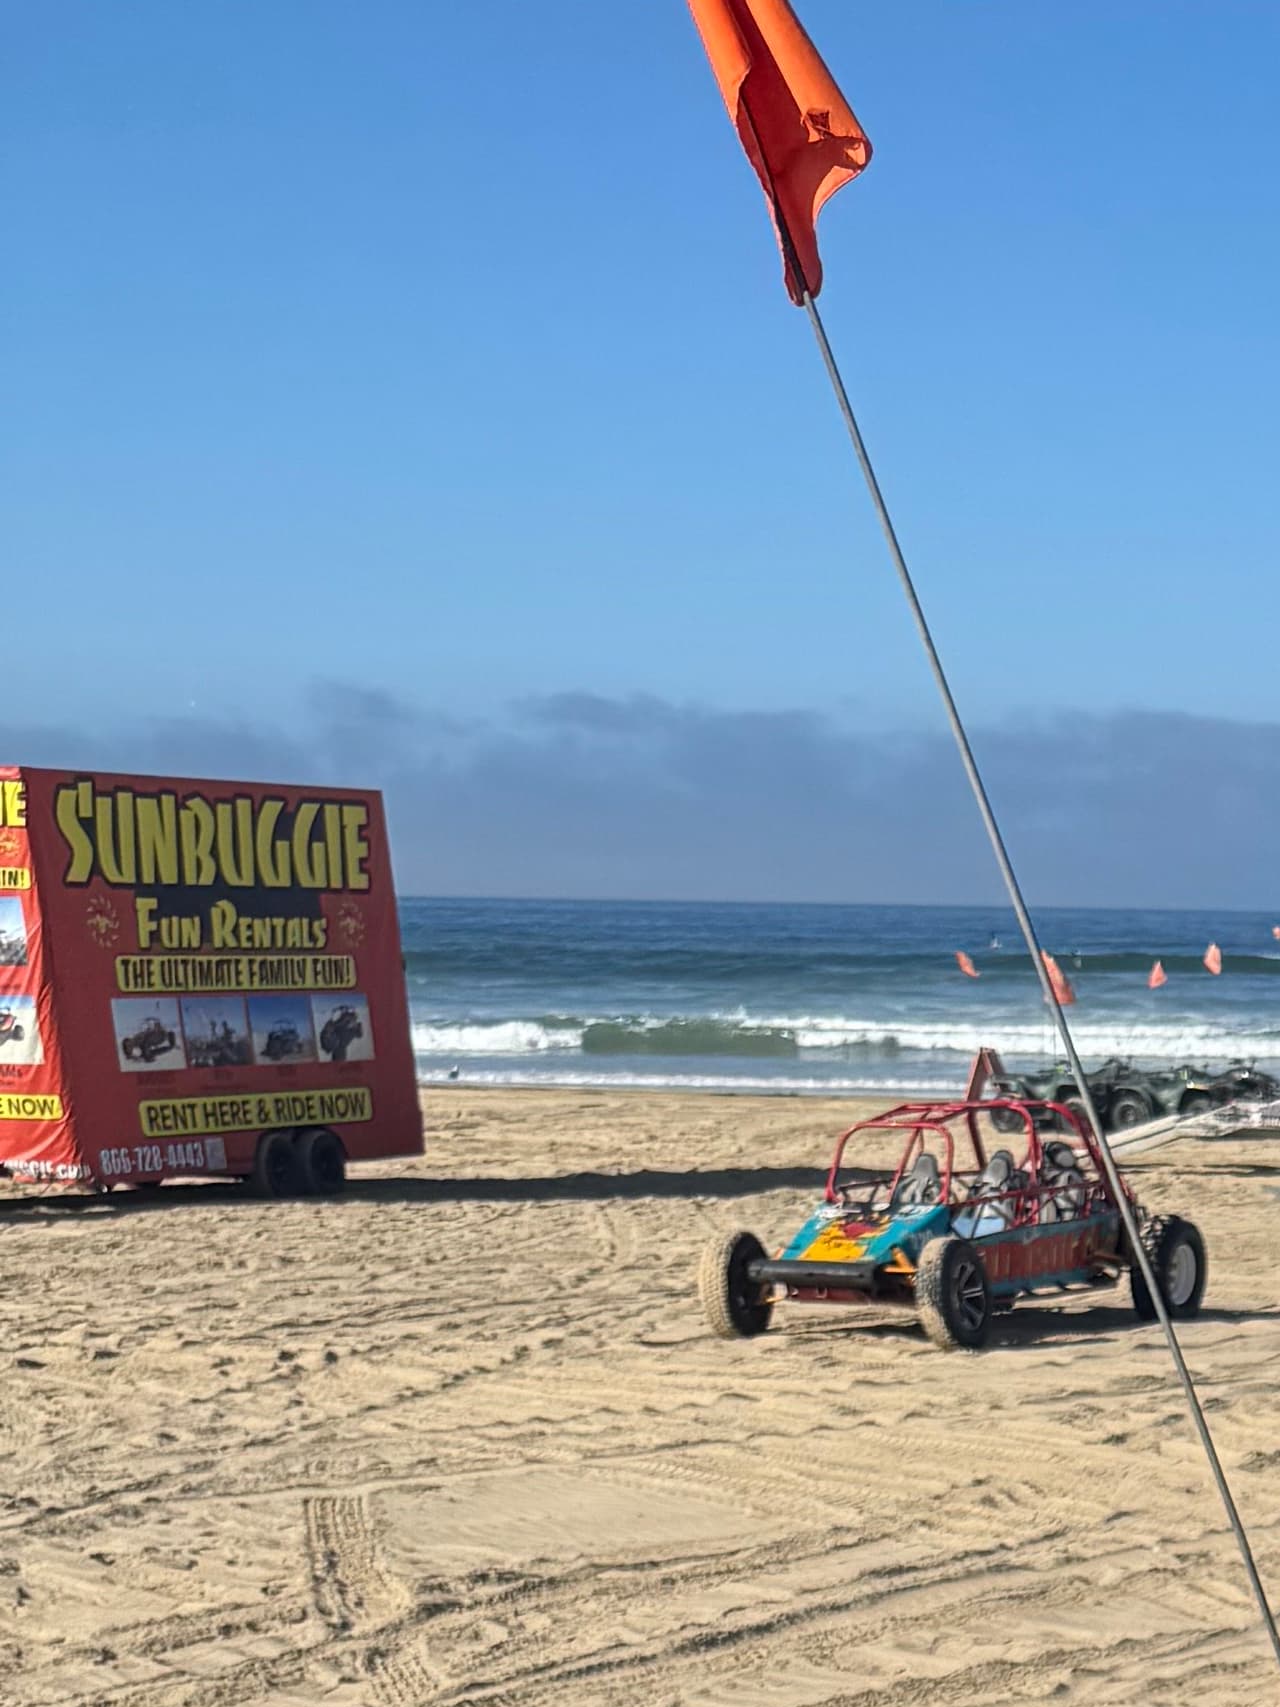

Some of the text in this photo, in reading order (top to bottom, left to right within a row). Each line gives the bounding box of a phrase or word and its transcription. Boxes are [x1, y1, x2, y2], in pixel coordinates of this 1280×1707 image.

[55, 780, 370, 889] SUNBUGGIE
[121, 957, 351, 988] THE ULTIMATE FAMILY FUN!
[7, 1098, 55, 1116] NOW
[146, 1091, 367, 1133] RENT HERE & RIDE NOW
[100, 1142, 205, 1176] 866-728-4443
